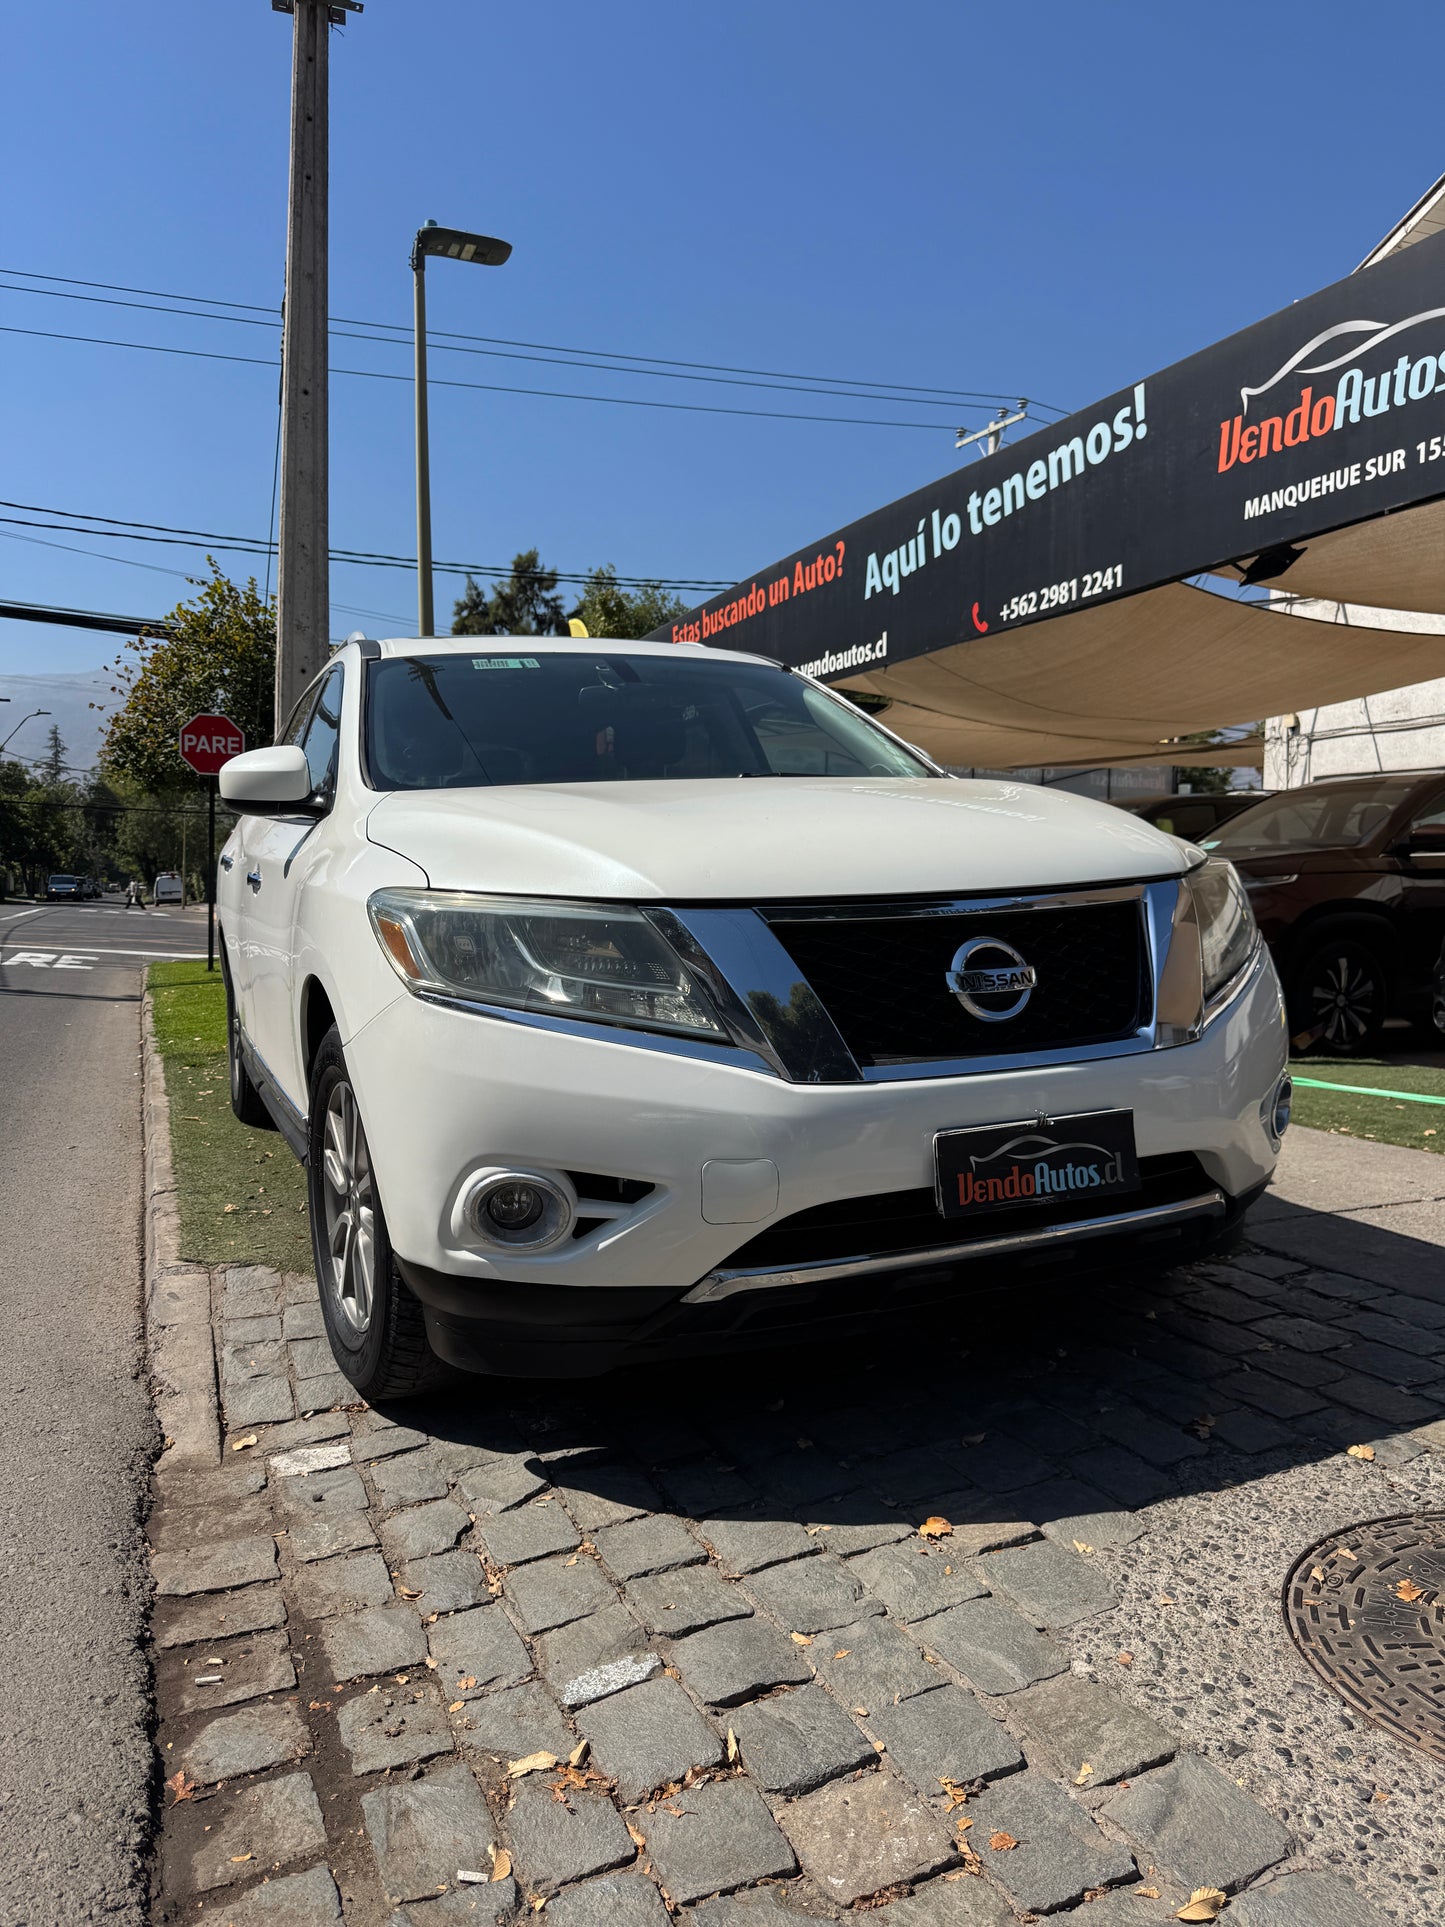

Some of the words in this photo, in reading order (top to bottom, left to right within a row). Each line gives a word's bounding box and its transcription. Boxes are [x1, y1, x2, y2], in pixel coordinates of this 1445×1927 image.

[864, 517, 926, 600] Aquí
[932, 508, 962, 559] lo
[967, 382, 1148, 535] tenemos!
[1244, 462, 1362, 520] MANQUEHUE
[1365, 448, 1407, 481] SUR
[1416, 434, 1445, 464] 15
[672, 620, 701, 644] Estas
[702, 583, 765, 639] buscando
[769, 576, 789, 608] un
[793, 541, 846, 597] Auto?
[1000, 592, 1038, 621] +562
[1040, 578, 1078, 611] 2981
[1082, 564, 1123, 598] 2241
[183, 734, 241, 755] PARE
[960, 971, 1033, 990] NISSAN
[957, 1151, 1125, 1206] VendoAutos.cl
